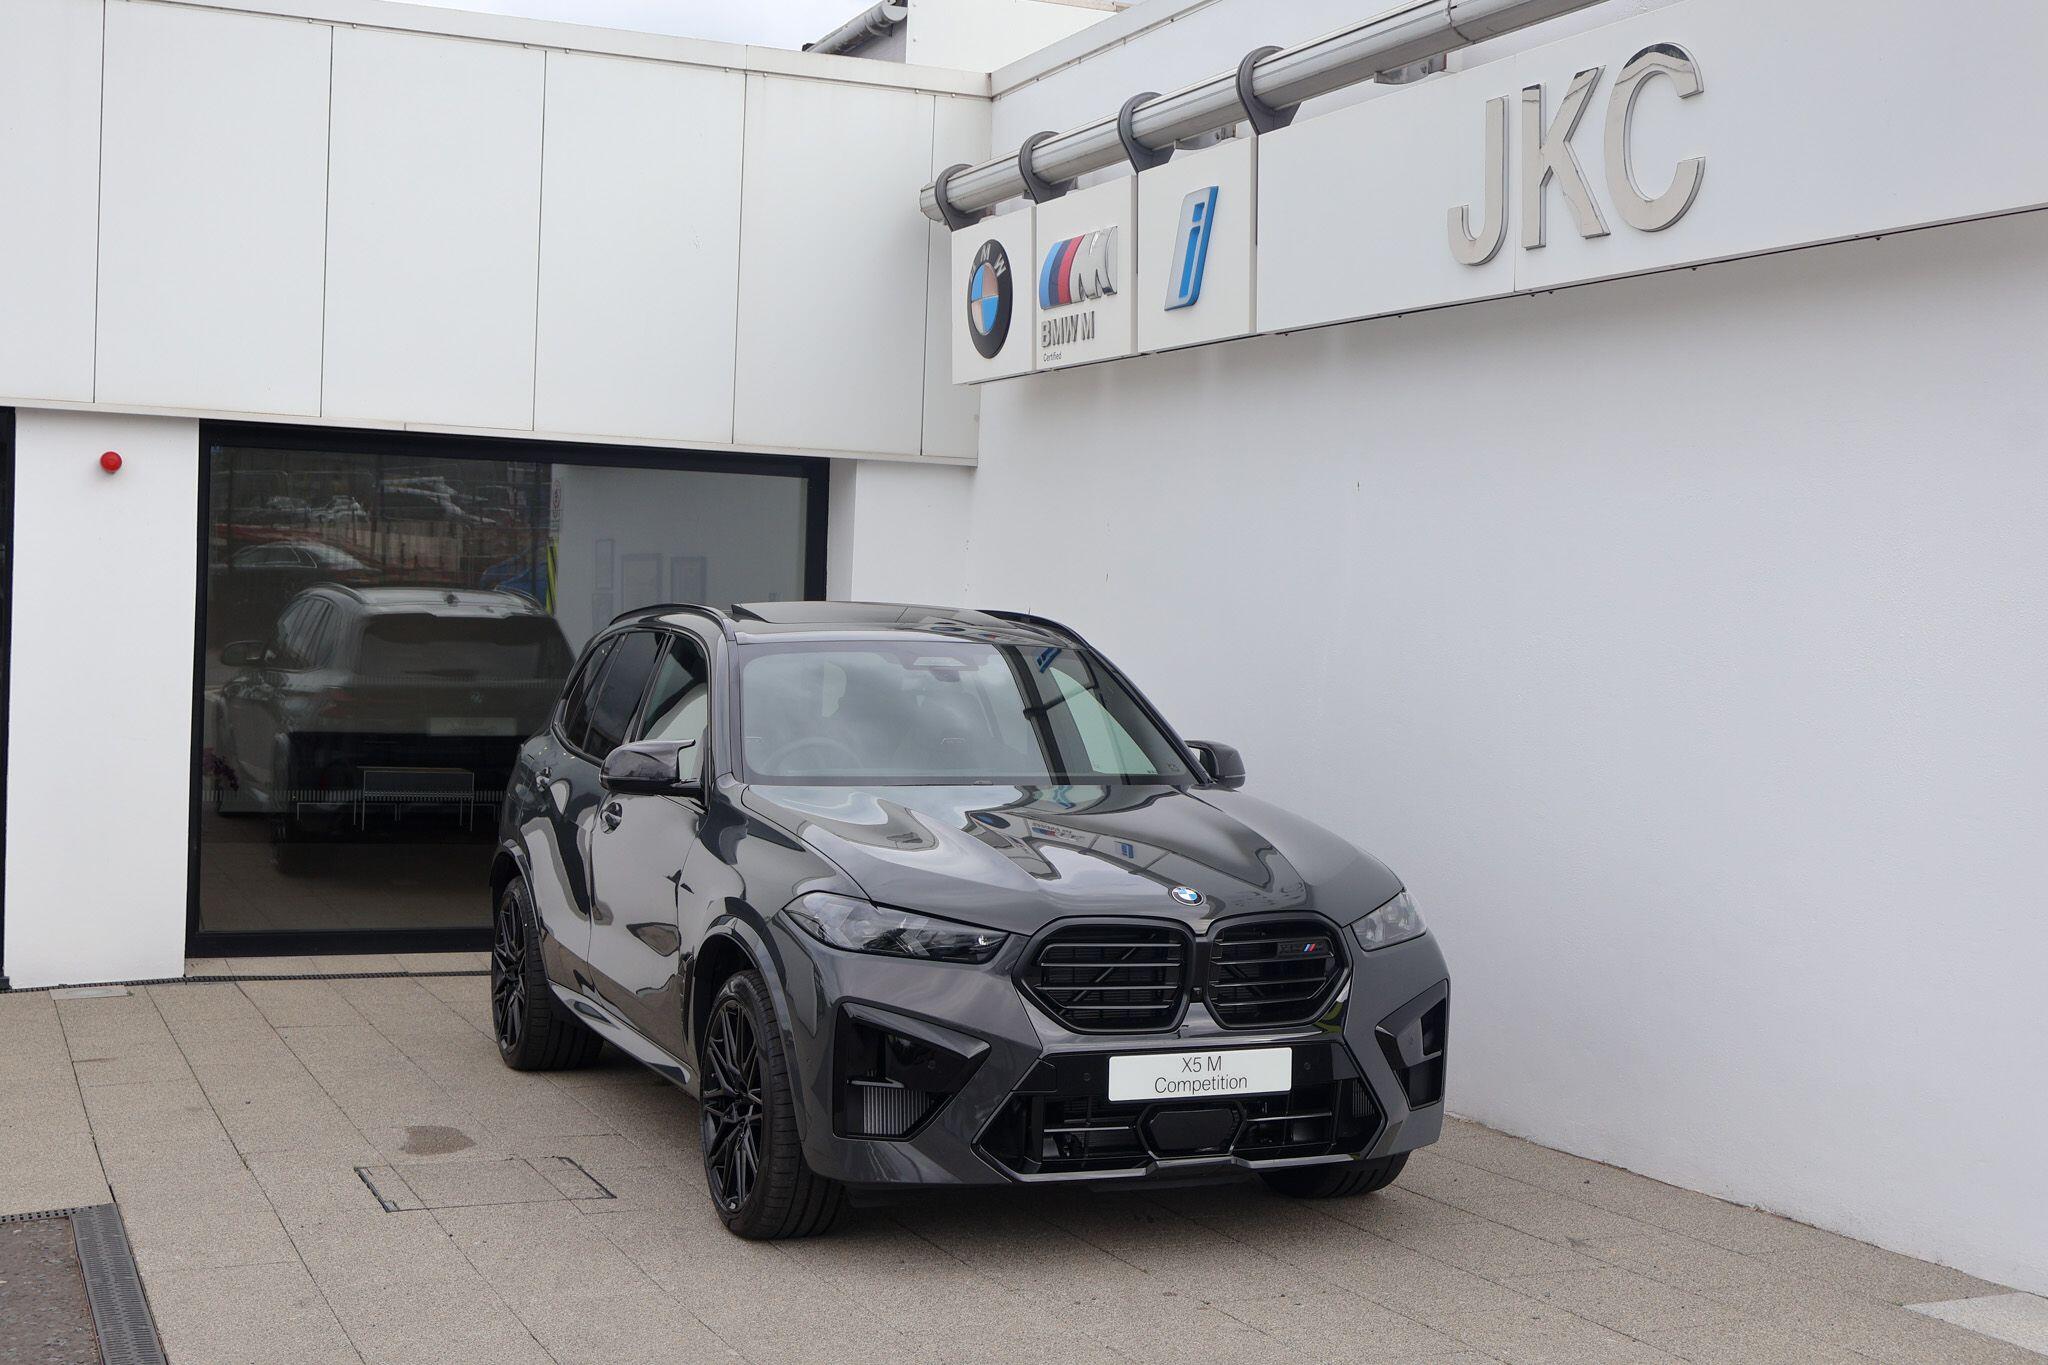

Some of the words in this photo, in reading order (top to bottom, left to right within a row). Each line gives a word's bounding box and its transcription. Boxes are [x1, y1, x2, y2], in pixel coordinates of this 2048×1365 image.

[1447, 42, 1706, 266] JKC
[1041, 314, 1079, 347] BMW
[1082, 311, 1095, 340] M
[1043, 351, 1062, 362] Certified
[1181, 1057, 1202, 1073] X5
[1207, 1055, 1222, 1072] M
[1154, 1074, 1248, 1094] Competition
